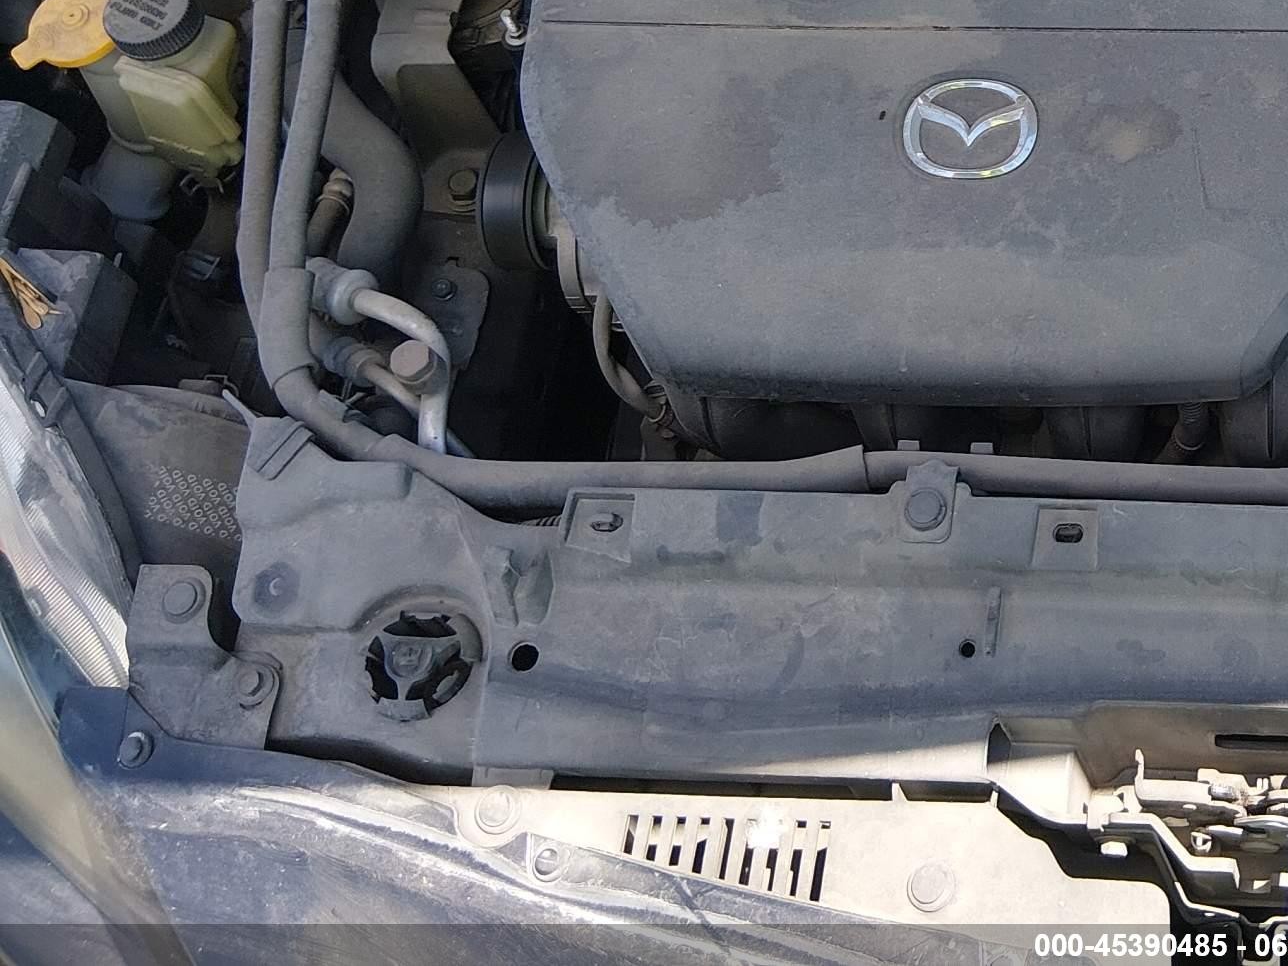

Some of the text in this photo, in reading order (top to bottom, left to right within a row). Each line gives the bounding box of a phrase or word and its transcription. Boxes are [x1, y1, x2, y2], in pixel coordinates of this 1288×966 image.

[172, 470, 191, 497] VOID
[187, 474, 206, 500] VOID
[202, 478, 221, 504] VOID
[187, 498, 207, 524] VOID
[203, 502, 222, 529] VOID
[218, 506, 237, 533] VOID
